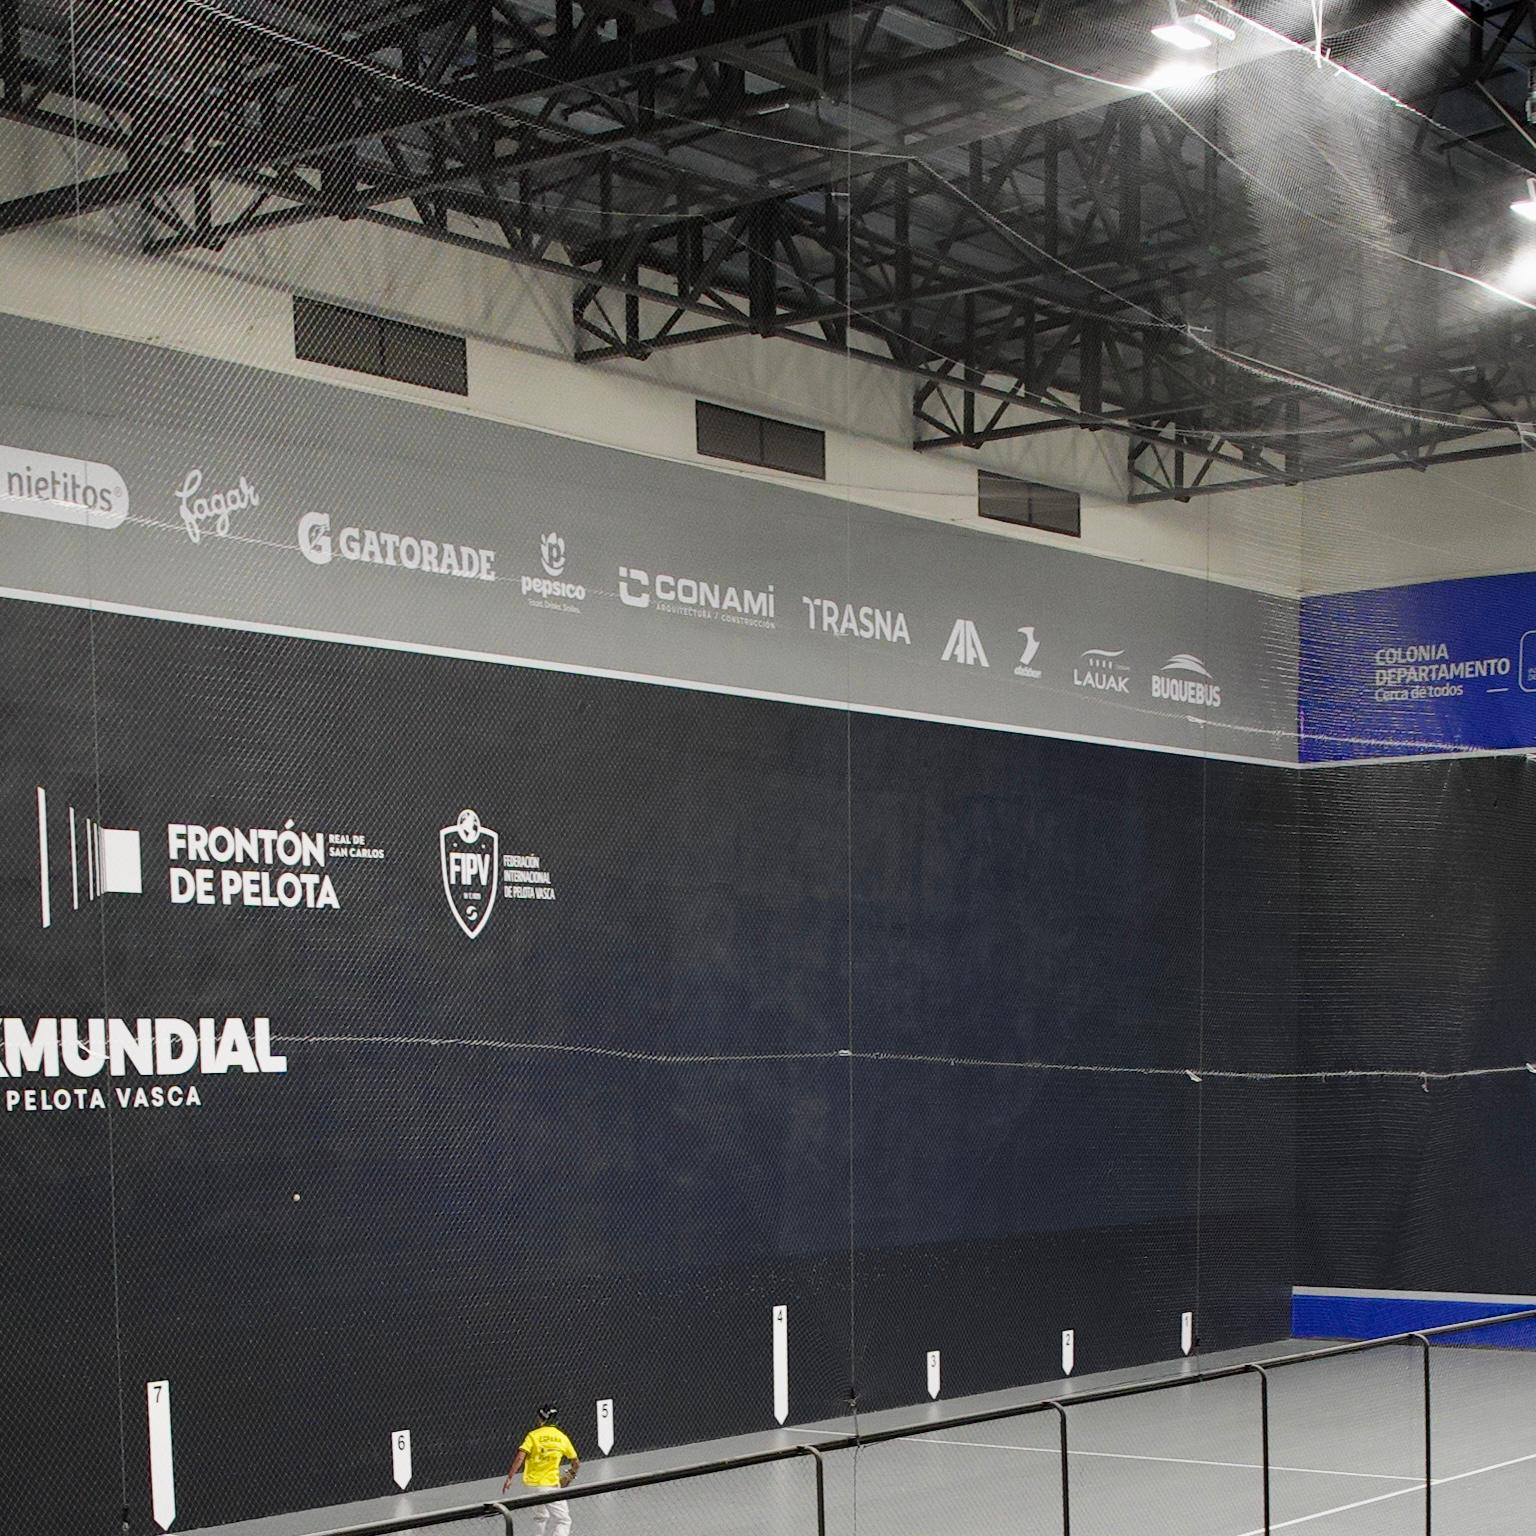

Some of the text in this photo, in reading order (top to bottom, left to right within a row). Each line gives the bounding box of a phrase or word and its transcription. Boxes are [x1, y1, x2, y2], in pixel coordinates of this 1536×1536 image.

[7, 462, 114, 514] nietitos
[338, 526, 496, 582] GATORADE
[520, 575, 586, 601] pepsico
[802, 595, 911, 645] TRASNA
[1375, 643, 1449, 666] COLONIA
[1073, 668, 1130, 693] LAUAK
[1375, 658, 1511, 686] DEPARTAMENTO
[1151, 675, 1222, 707] BUQUEBUS
[1375, 682, 1464, 702] Cerca de todos
[167, 817, 327, 868] FRONTÓN
[328, 833, 366, 846] REAL DE
[328, 846, 385, 859] SAN CARLOS
[448, 851, 490, 886] FIPV
[169, 866, 341, 910] DE PELOTA
[503, 885, 556, 900] DE PELOTA VASCA
[5, 1086, 202, 1112] PELOTA VASCA
[776, 1309, 784, 1324] 4
[153, 1385, 163, 1404] 7
[601, 1404, 609, 1419] 5
[397, 1435, 406, 1451] 6
